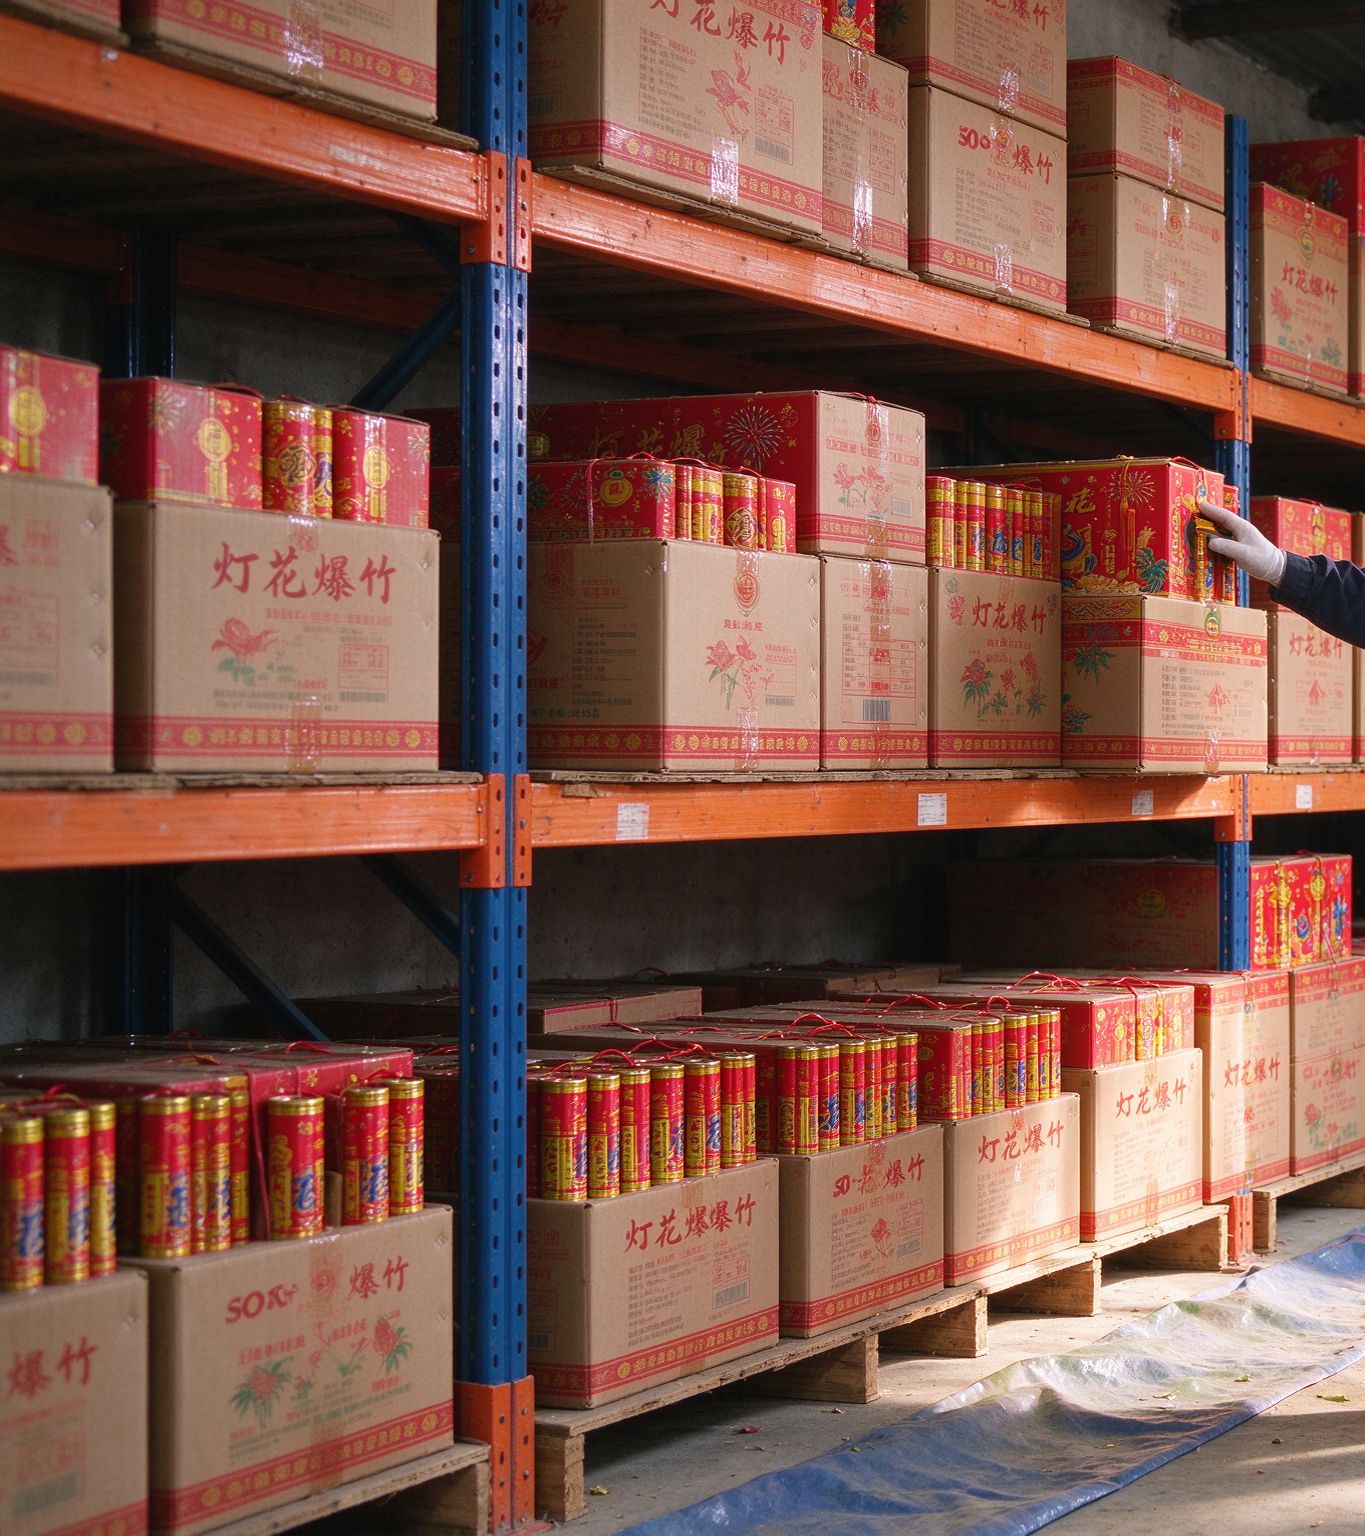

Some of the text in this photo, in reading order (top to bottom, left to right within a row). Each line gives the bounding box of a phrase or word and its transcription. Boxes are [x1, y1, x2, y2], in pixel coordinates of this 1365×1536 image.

[986, 0, 1050, 32] 爆竹
[1282, 261, 1338, 305] 灯花爆竹
[211, 541, 397, 605] 灯花爆竹
[972, 595, 1047, 635] 灯花爆竹
[1289, 632, 1343, 660] 灯花爆竹
[1224, 1053, 1281, 1088] 灯花爆竹
[1115, 1078, 1187, 1118] 灯花爆竹
[978, 1119, 1064, 1164] 灯花爆竹
[624, 1193, 757, 1253] 灯花爆爆竹
